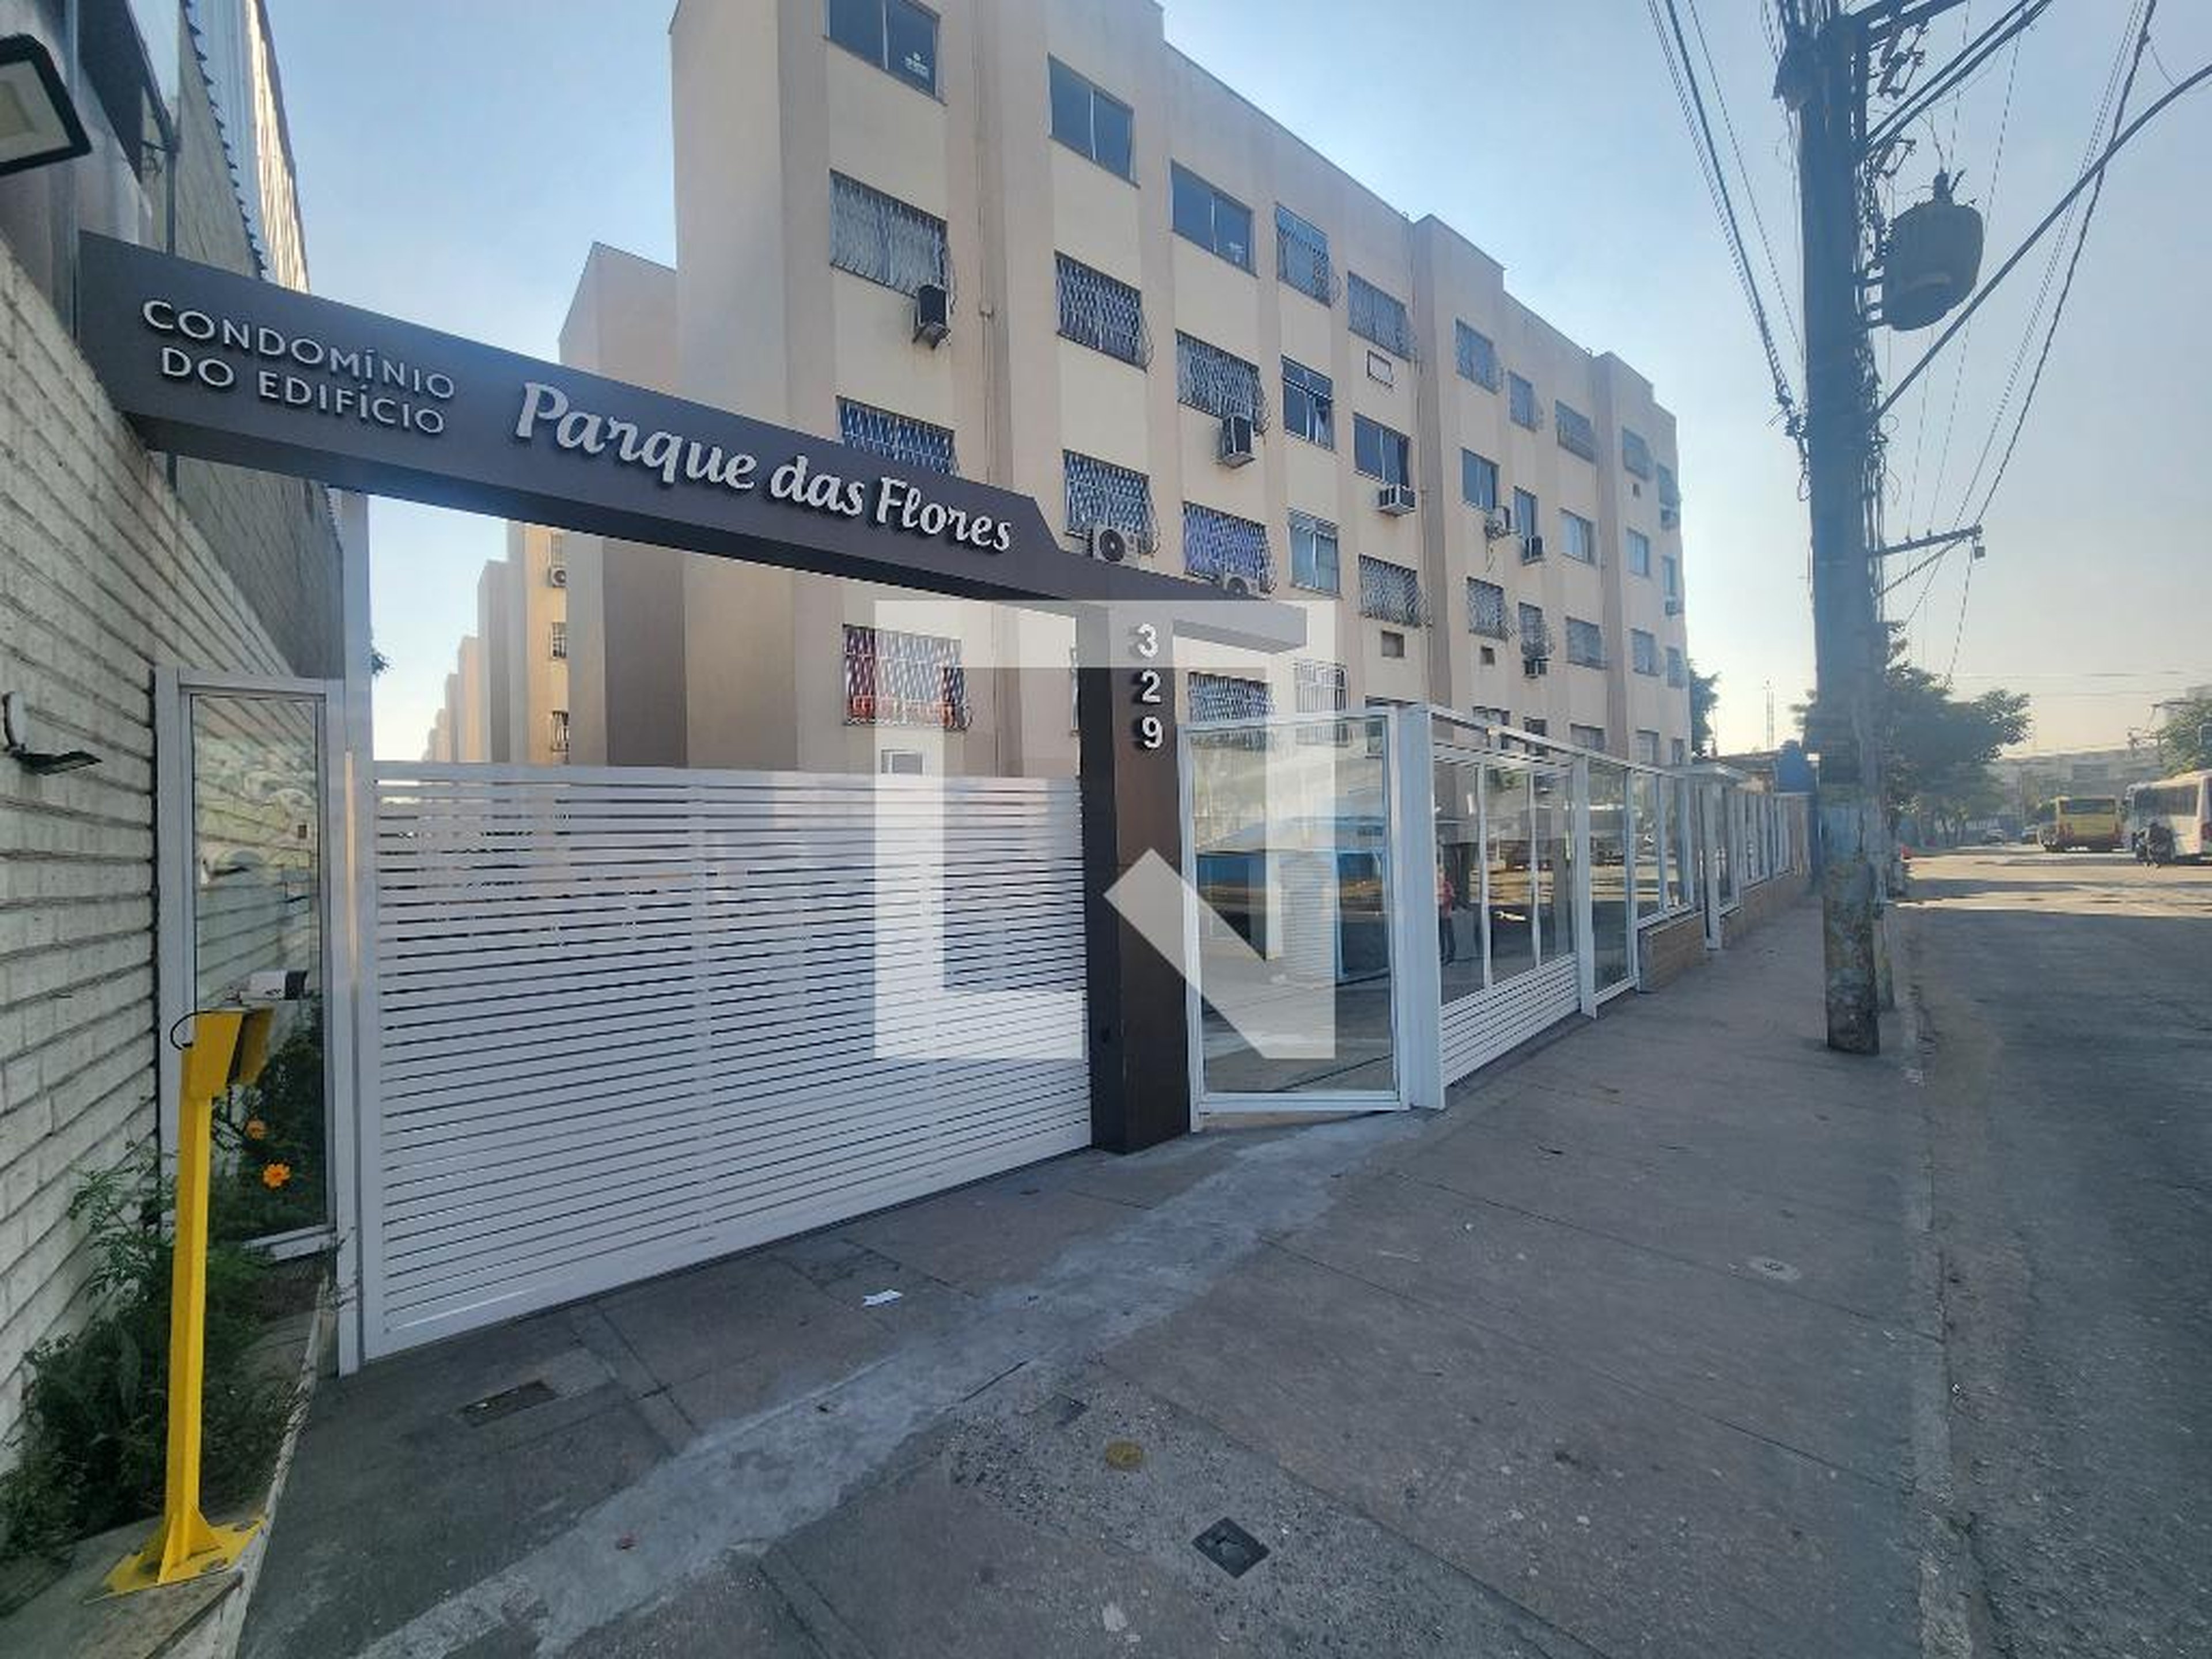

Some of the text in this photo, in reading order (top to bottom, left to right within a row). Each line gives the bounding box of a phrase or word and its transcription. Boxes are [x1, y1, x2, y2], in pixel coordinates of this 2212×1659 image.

[142, 300, 455, 399] CONDOMÍNIO
[161, 348, 445, 434] DO EDIFÍCIO
[516, 381, 1012, 551] Parque das Flores
